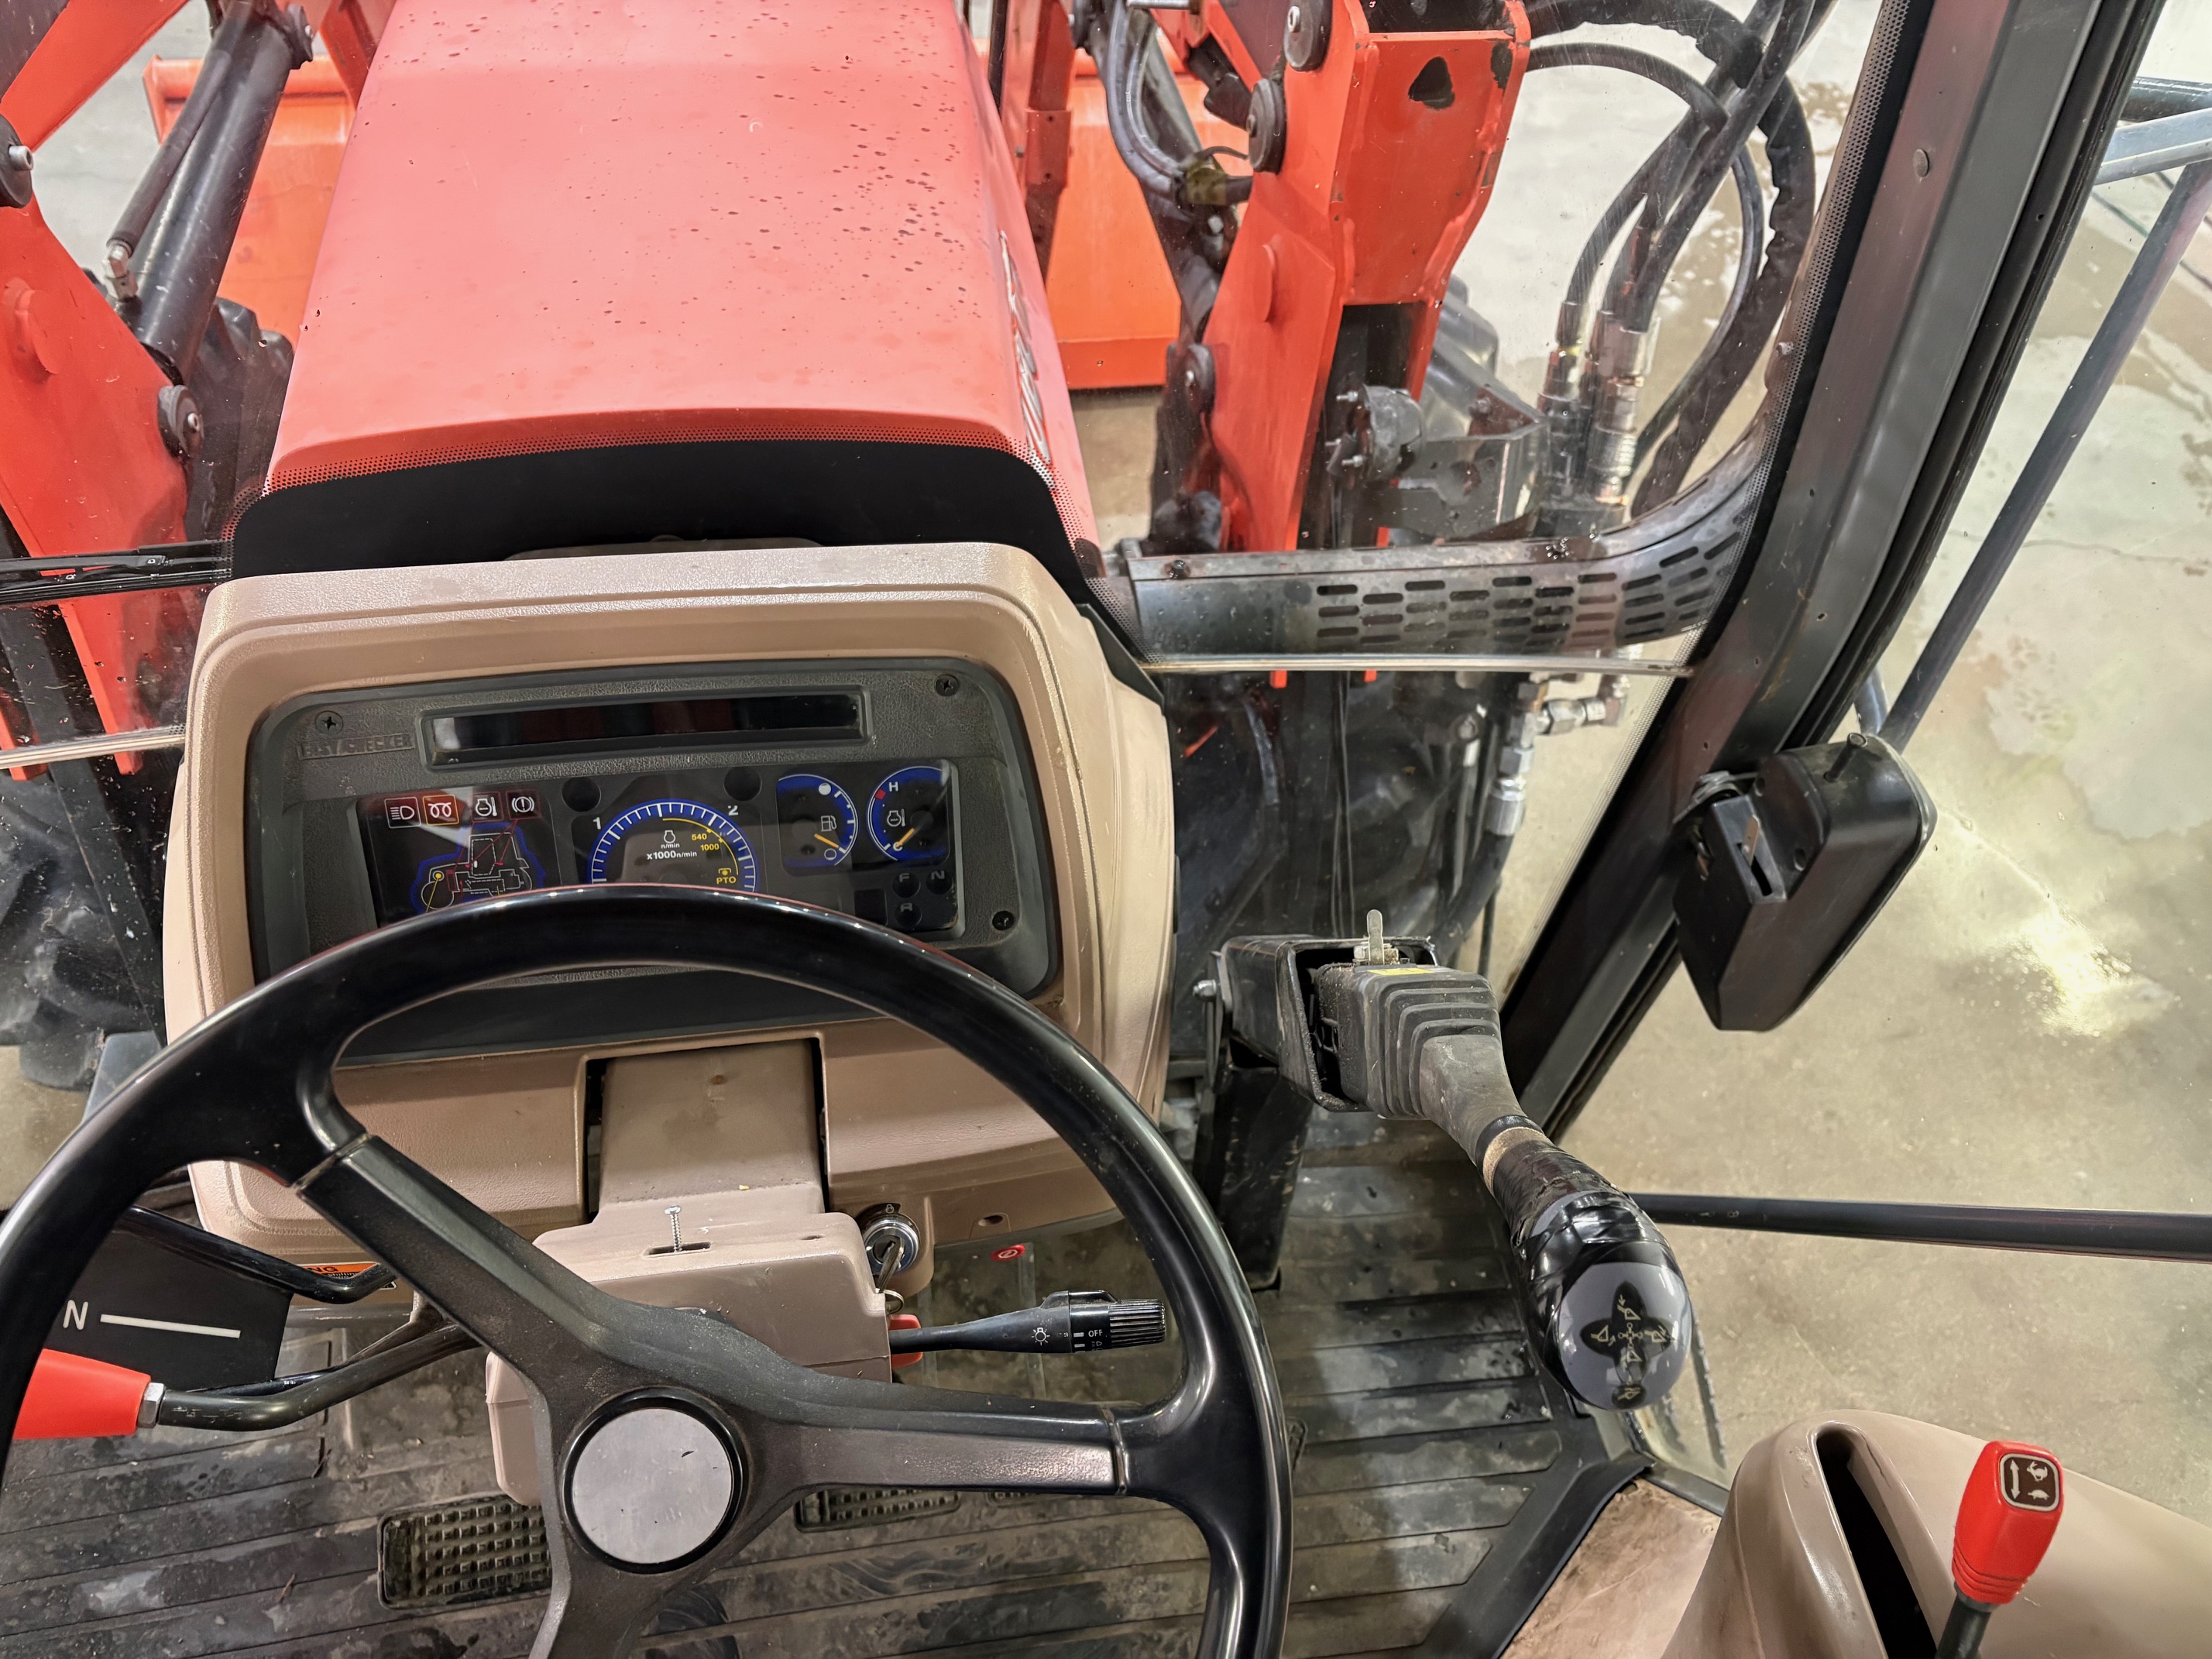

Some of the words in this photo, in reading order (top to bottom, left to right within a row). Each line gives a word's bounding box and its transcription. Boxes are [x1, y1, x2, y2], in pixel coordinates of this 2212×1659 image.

[889, 781, 898, 792] H
[728, 805, 739, 816] 2
[592, 816, 601, 830] 1
[692, 833, 707, 841] 540
[700, 843, 720, 852] 1000
[899, 872, 910, 882] F
[931, 870, 945, 880] N
[63, 1300, 88, 1330] N
[1088, 1329, 1103, 1338] OFF
